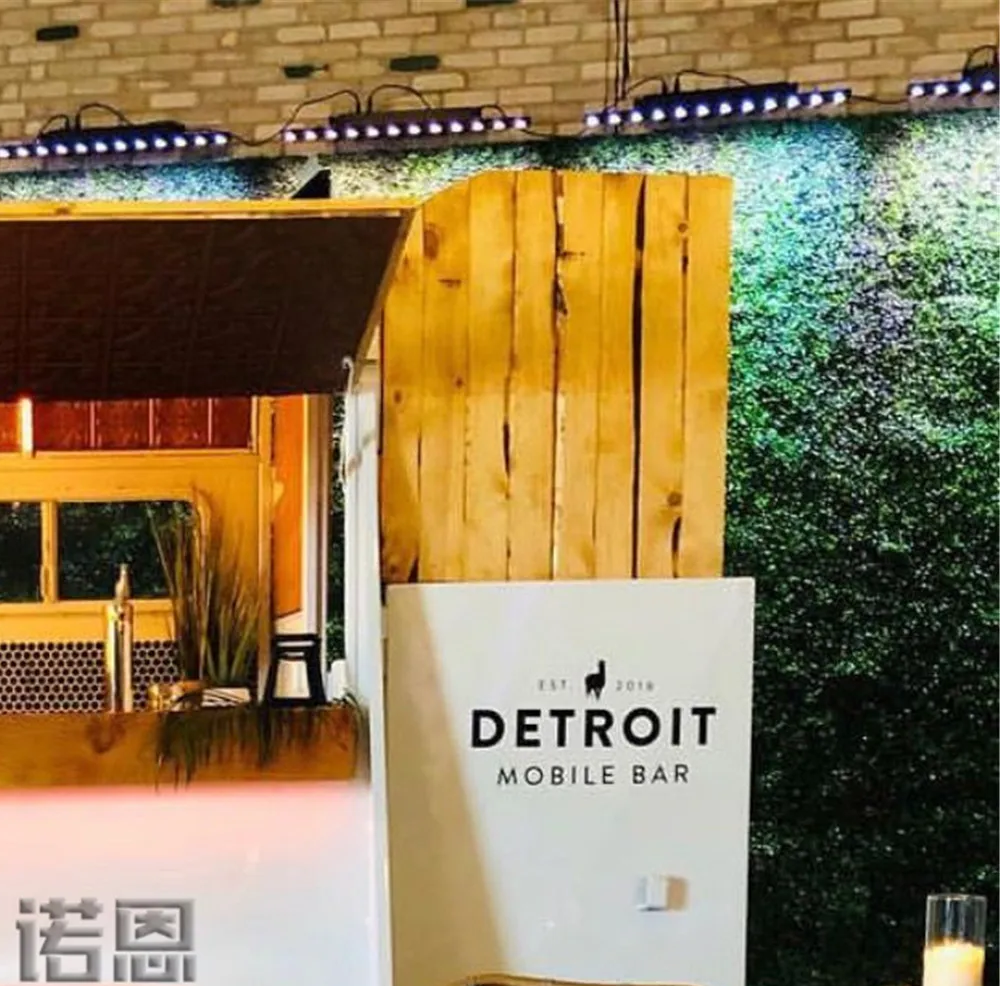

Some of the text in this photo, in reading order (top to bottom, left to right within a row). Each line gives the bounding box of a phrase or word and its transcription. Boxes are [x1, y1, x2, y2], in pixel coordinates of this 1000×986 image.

[471, 707, 716, 748] DETROIT
[497, 764, 689, 785] MOBILE BAR
